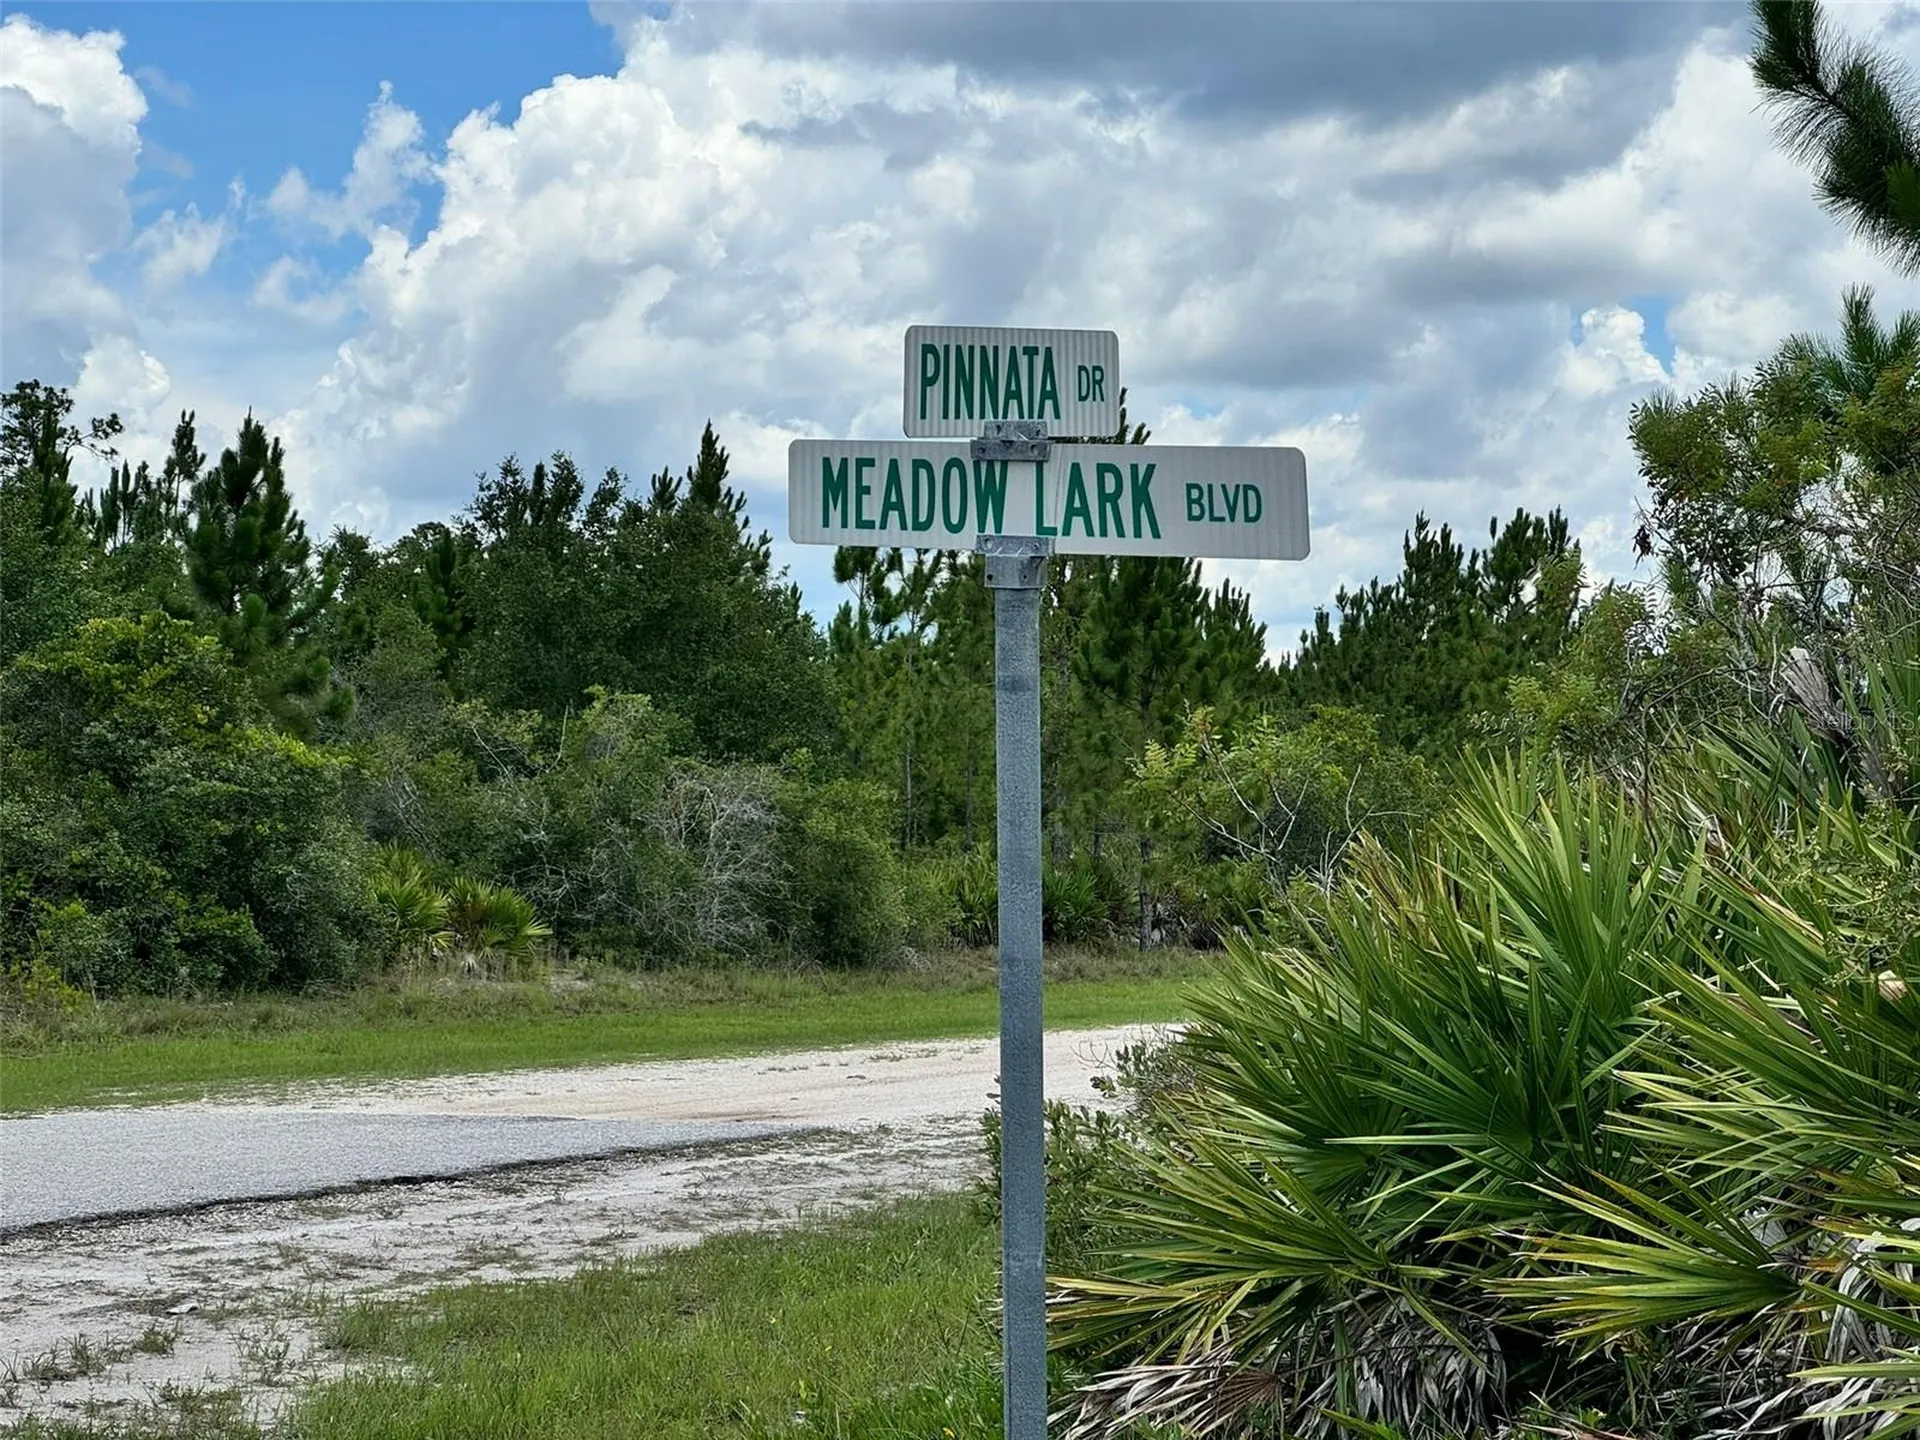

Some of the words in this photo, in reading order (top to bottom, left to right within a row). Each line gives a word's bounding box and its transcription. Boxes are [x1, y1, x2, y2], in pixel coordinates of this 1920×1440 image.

[919, 343, 1062, 421] PINNATA
[1077, 364, 1105, 403] DR
[821, 456, 1009, 536] MEADOW
[1035, 460, 1161, 540] LARK
[1185, 481, 1264, 524] BLVD
